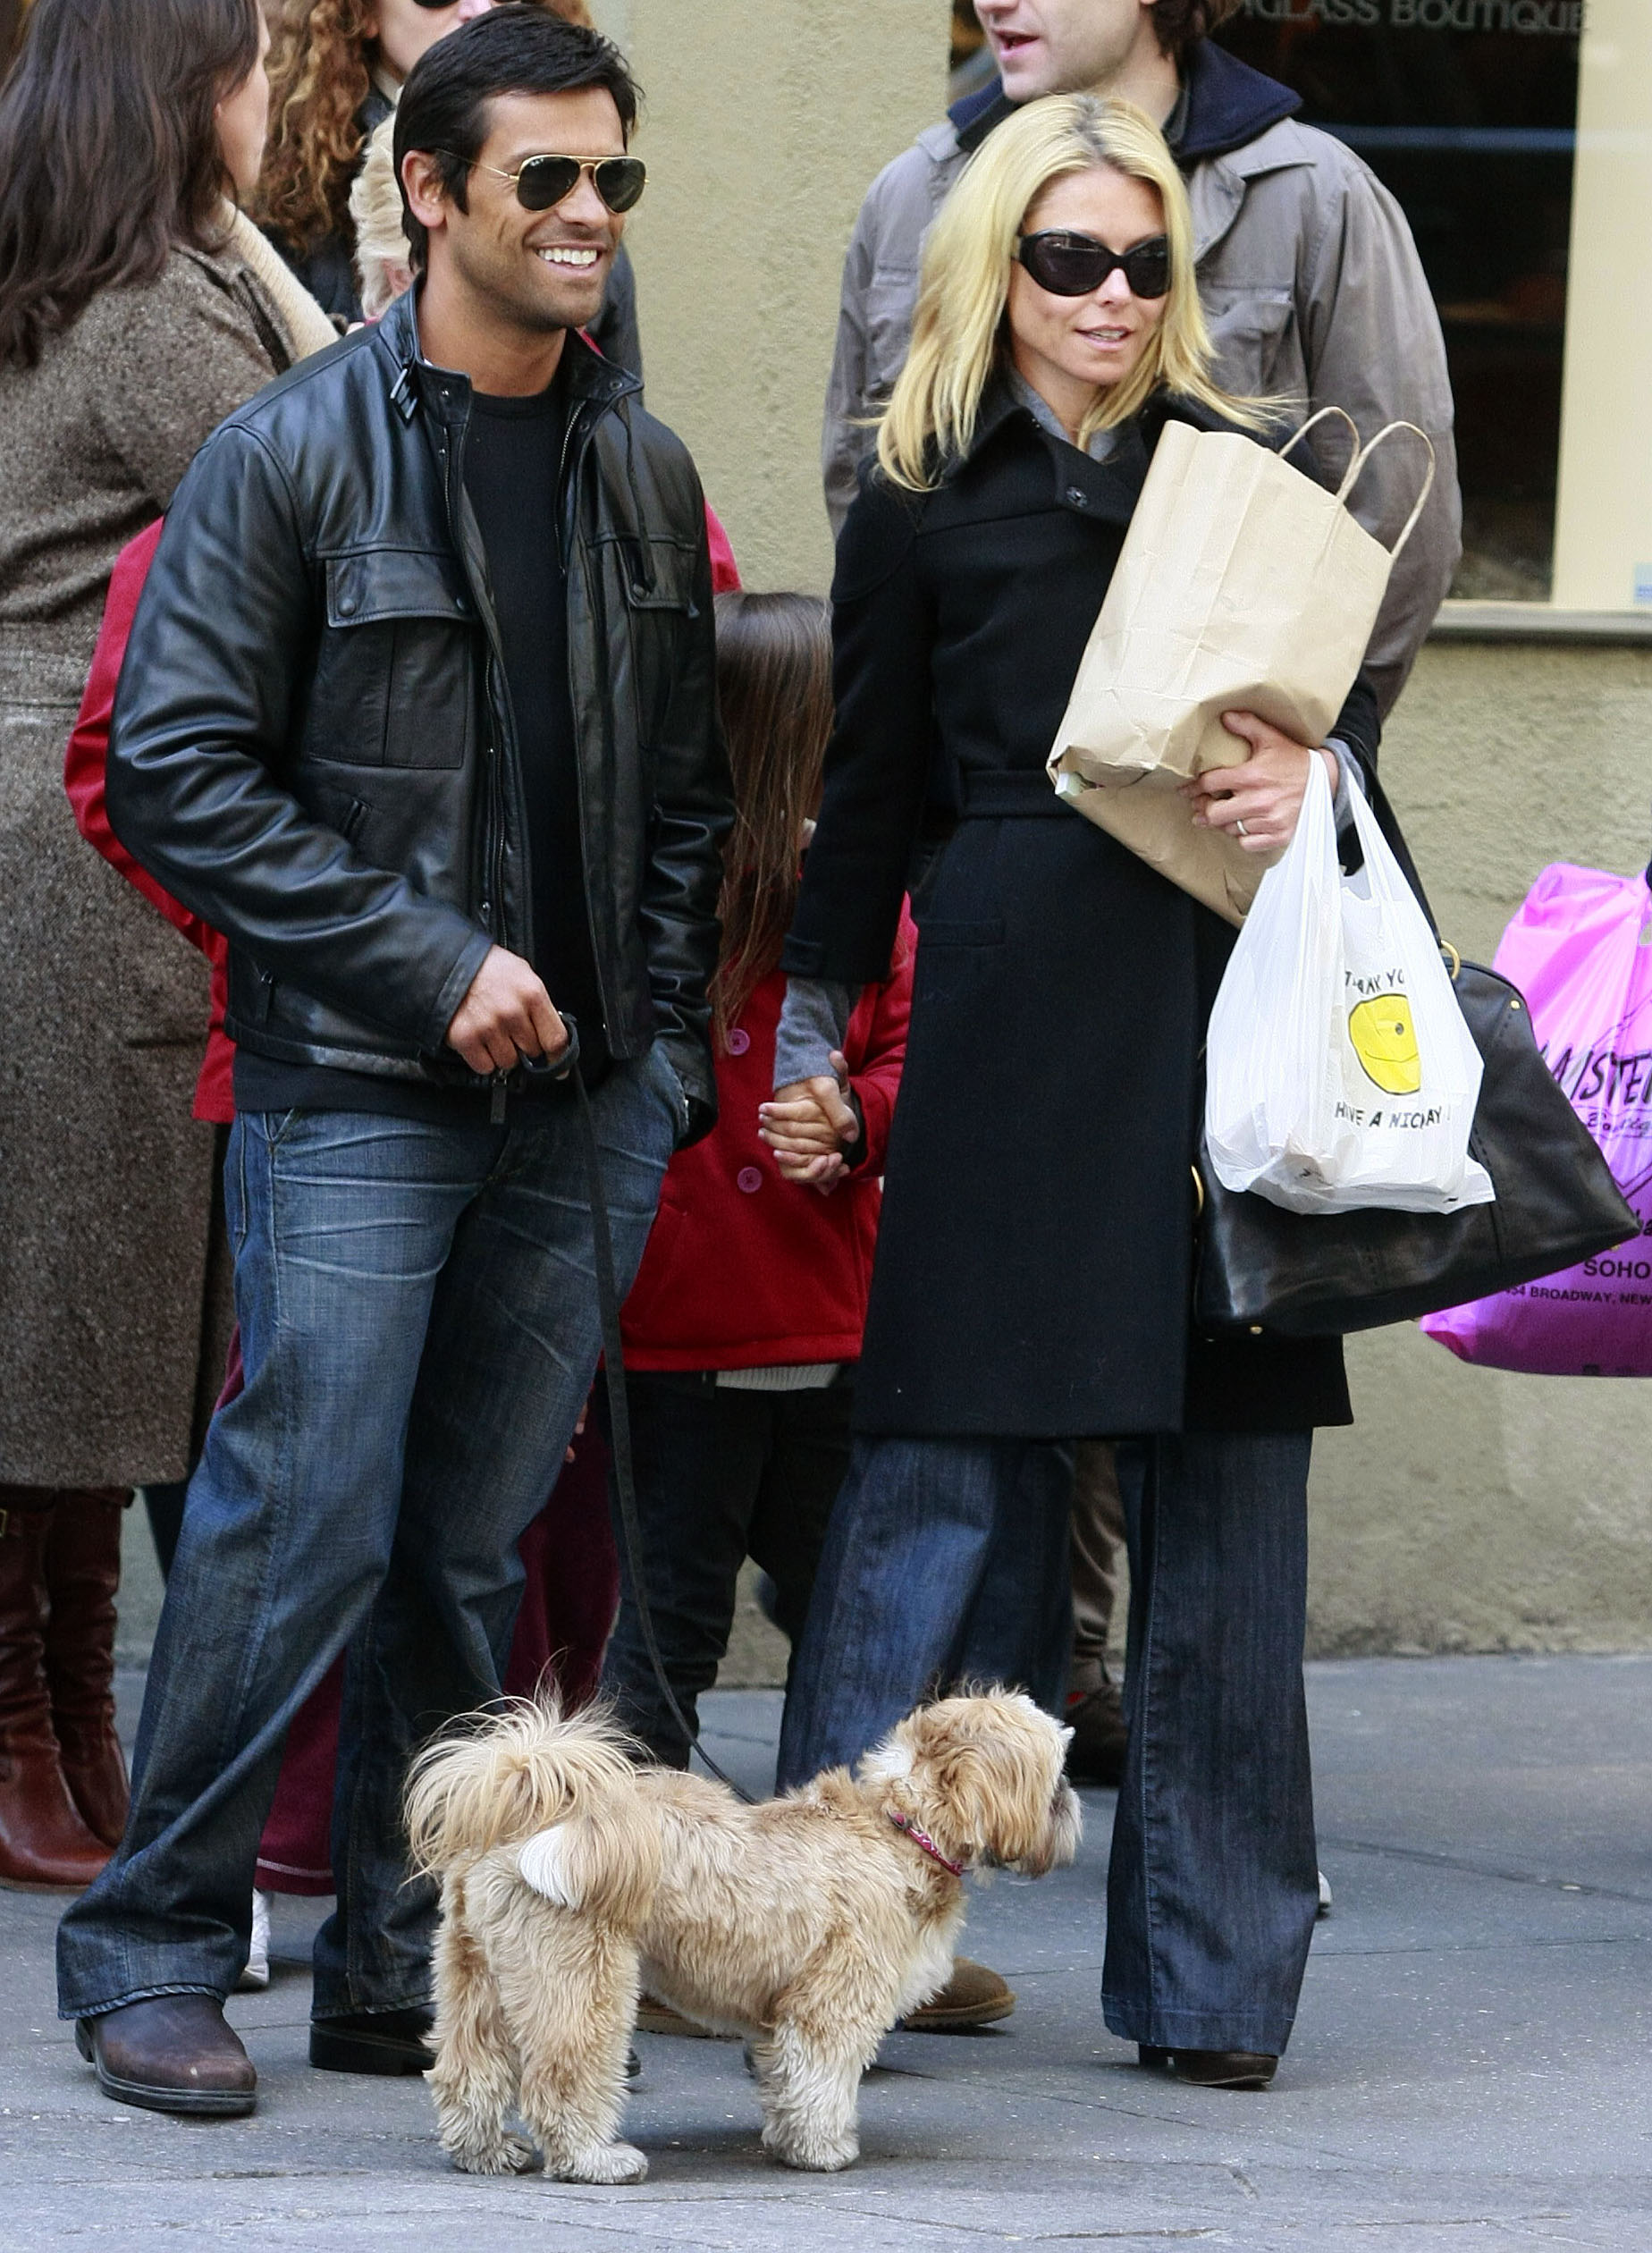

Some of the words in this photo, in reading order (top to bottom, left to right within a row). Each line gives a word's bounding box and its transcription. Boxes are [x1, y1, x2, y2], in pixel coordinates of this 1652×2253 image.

[1390, 0, 1586, 34] BOUTIQUE
[1369, 1110, 1383, 1127] A
[1583, 1258, 1651, 1279] SOHO
[1530, 1286, 1615, 1304] BROADWAY,
[1620, 1294, 1652, 1306] NEW
